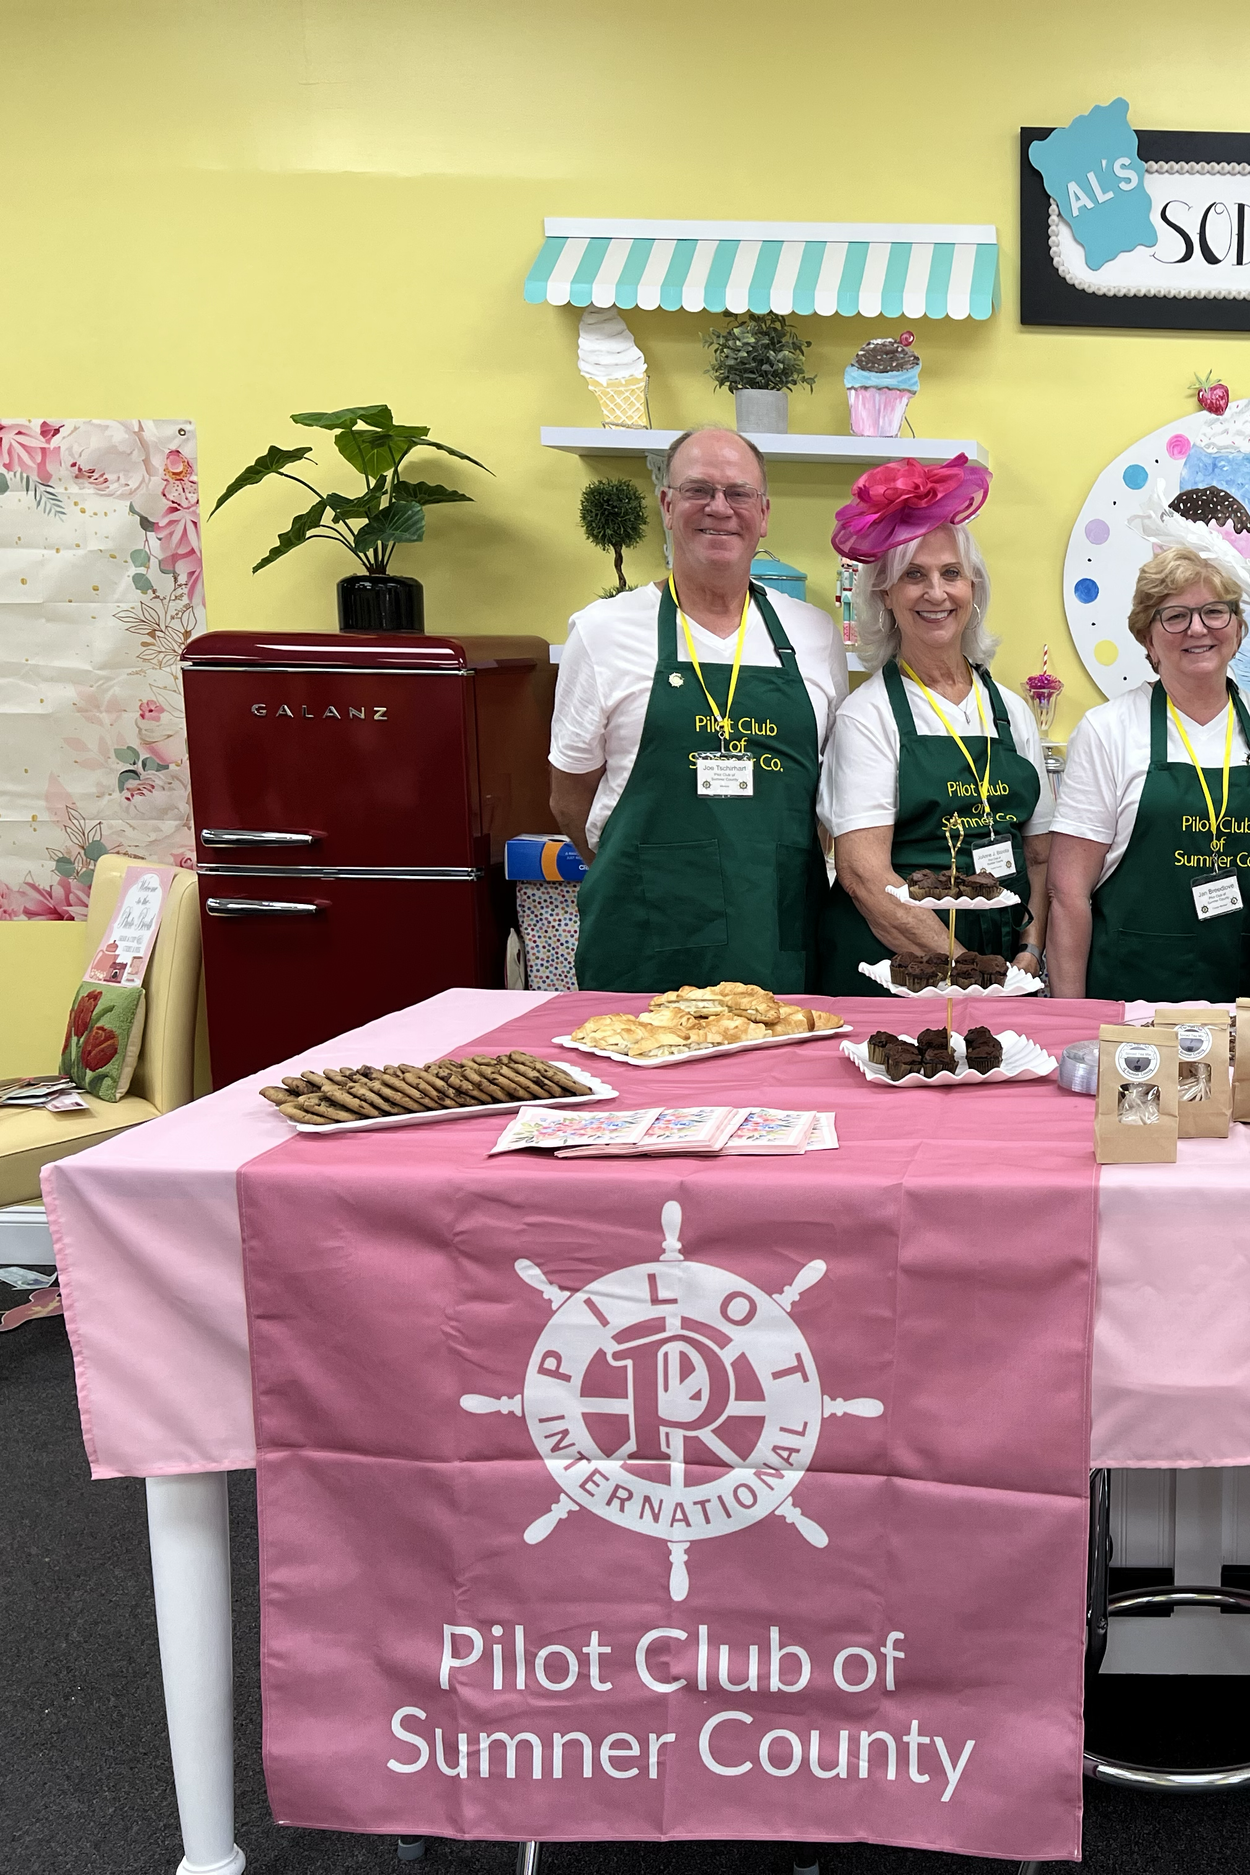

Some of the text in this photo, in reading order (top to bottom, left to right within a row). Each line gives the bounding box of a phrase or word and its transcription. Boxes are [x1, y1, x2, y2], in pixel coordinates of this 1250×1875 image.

[1066, 156, 1140, 218] AL'S
[251, 703, 388, 720] GALANZ
[738, 717, 777, 736] Club
[729, 737, 748, 753] of
[760, 753, 784, 772] Co.
[946, 781, 978, 797] Pilot
[1182, 815, 1215, 832] Pilo
[1210, 836, 1227, 852] of
[537, 1271, 811, 1384] PILOT
[538, 1414, 808, 1529] INTERNATIONAL
[439, 1624, 905, 1693] Pilot Club of
[386, 1706, 976, 1802] Sumner County
